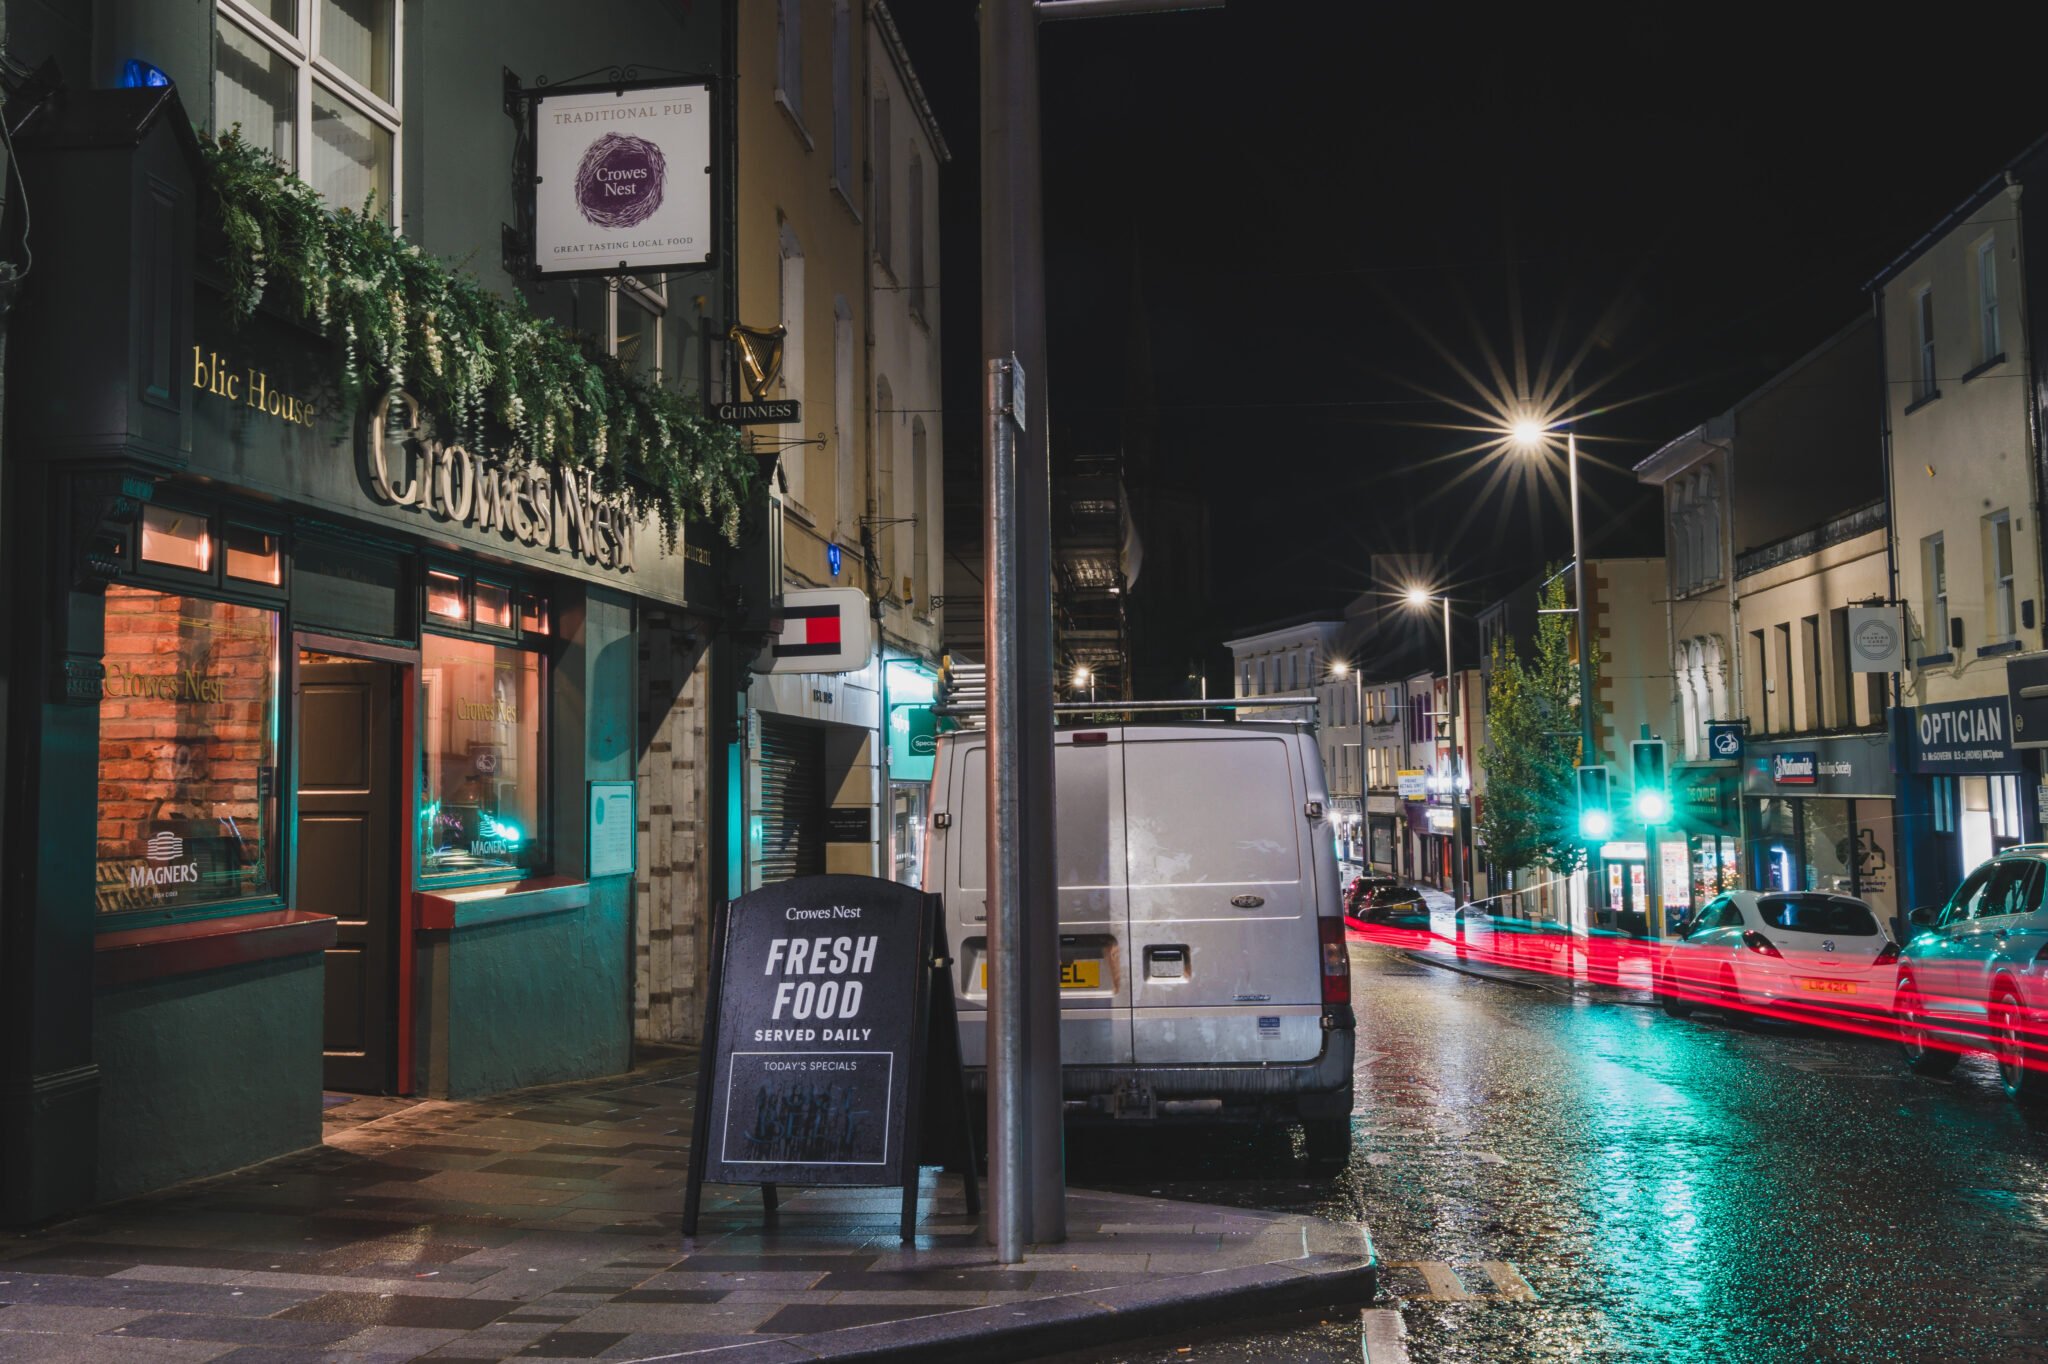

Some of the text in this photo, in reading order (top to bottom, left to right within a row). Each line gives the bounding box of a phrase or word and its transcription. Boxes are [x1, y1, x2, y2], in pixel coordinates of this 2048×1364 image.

[553, 103, 693, 125] TRADITIONAL PUB
[596, 166, 648, 182] Crowes
[604, 182, 636, 197] Nest
[553, 236, 694, 254] GREAT TASTING LOCAL FOOD
[192, 345, 315, 428] blic House
[719, 404, 792, 420] GUINNESS
[372, 389, 638, 573] Crowes Nest
[105, 661, 225, 703] Crowes Nest
[456, 696, 494, 722] Crowes
[1920, 706, 2003, 745] OPTICIAN
[1781, 757, 1813, 776] Nationwide
[1817, 761, 1852, 777] Building Society
[471, 839, 507, 856] MAGNERS
[130, 862, 198, 888] MAGNERS
[165, 890, 178, 898] CIDER
[785, 905, 862, 921] Crowes Nest
[764, 936, 879, 976] FRESH
[1060, 963, 1086, 983] EL
[771, 980, 864, 1020] FOOD
[754, 1028, 872, 1042] SERVED DAILY
[764, 1061, 857, 1071] TODAY'S SPECIALS
